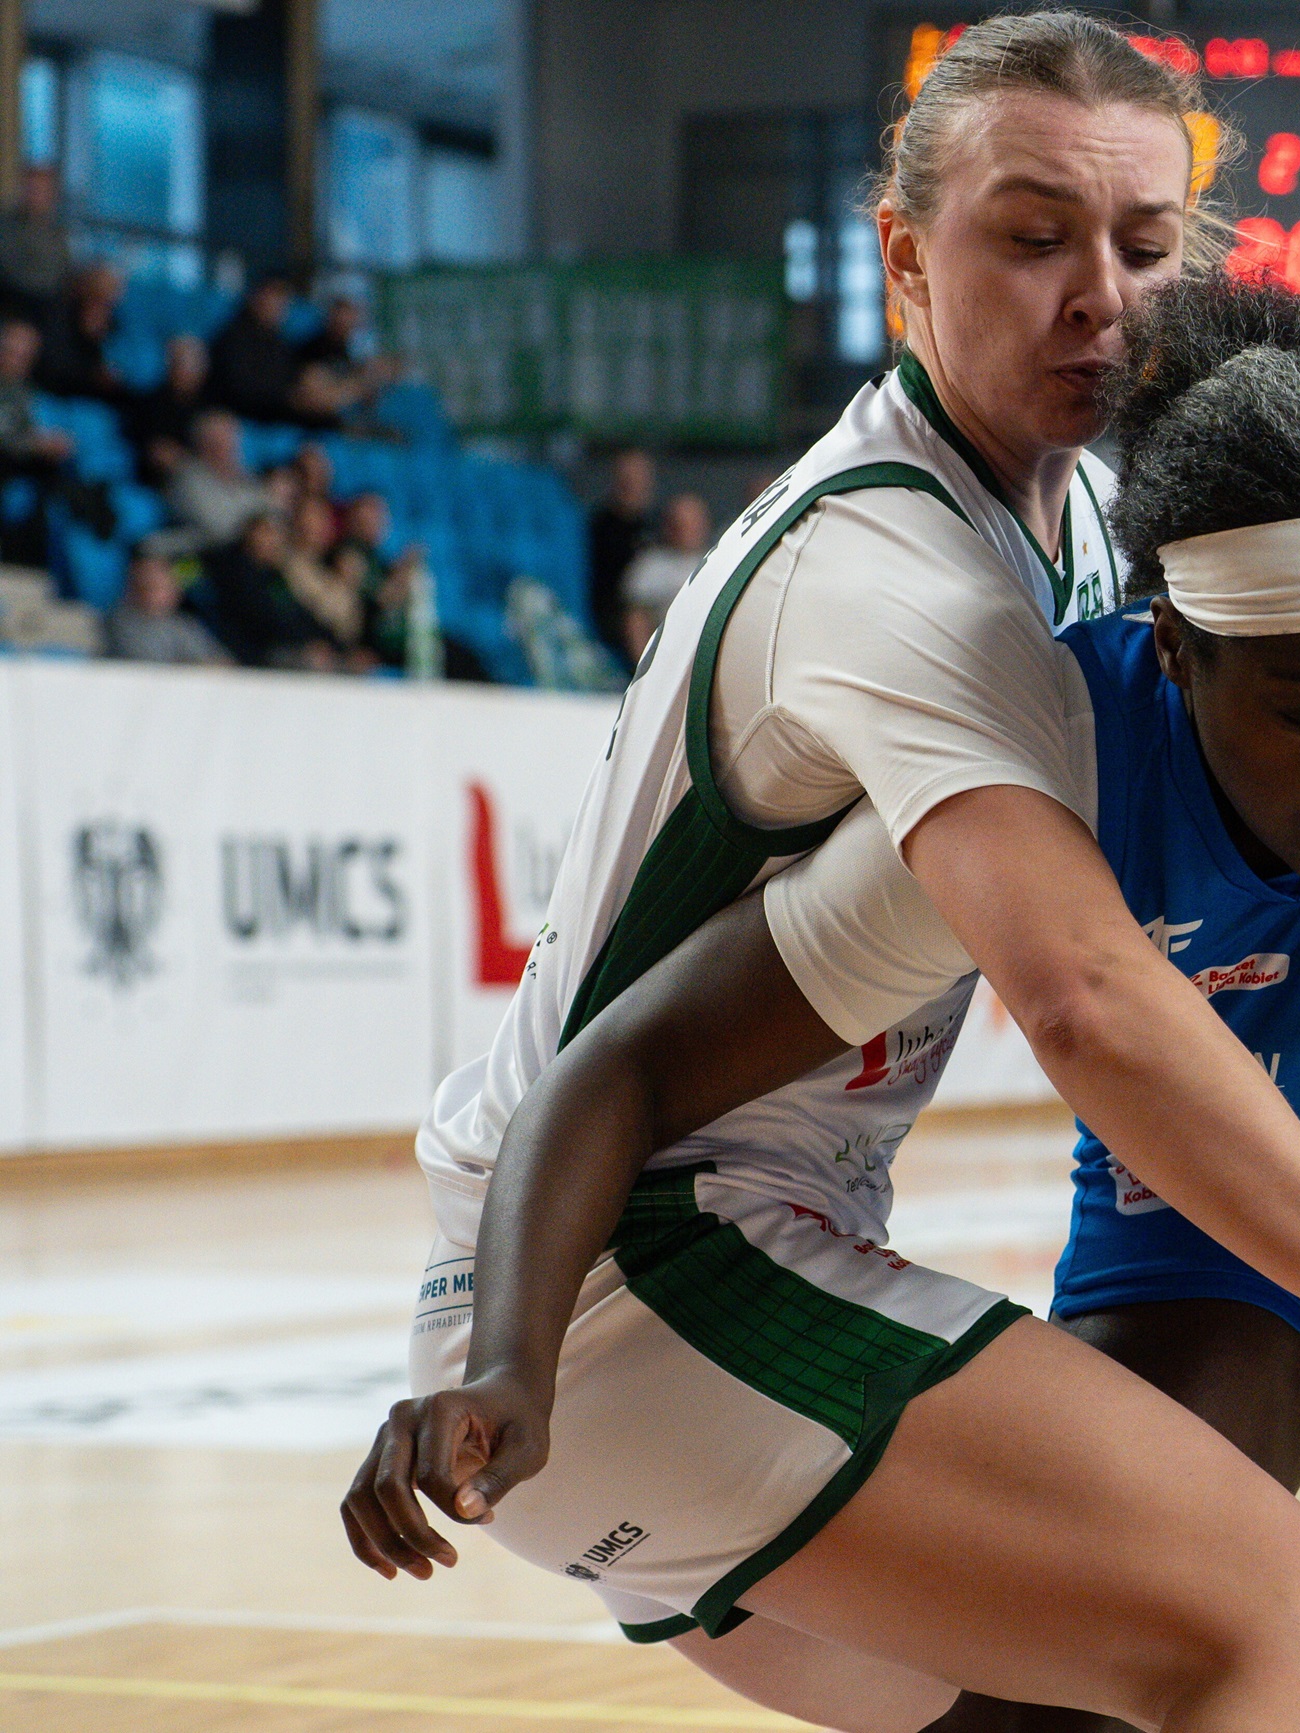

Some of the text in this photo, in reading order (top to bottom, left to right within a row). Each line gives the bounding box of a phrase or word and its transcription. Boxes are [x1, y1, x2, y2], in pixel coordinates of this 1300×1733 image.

[222, 833, 407, 942] UMCS
[1238, 971, 1280, 985] Kobiet
[452, 1271, 475, 1294] ME
[426, 1311, 473, 1333] REHABILIT
[582, 1521, 644, 1563] UMCS
